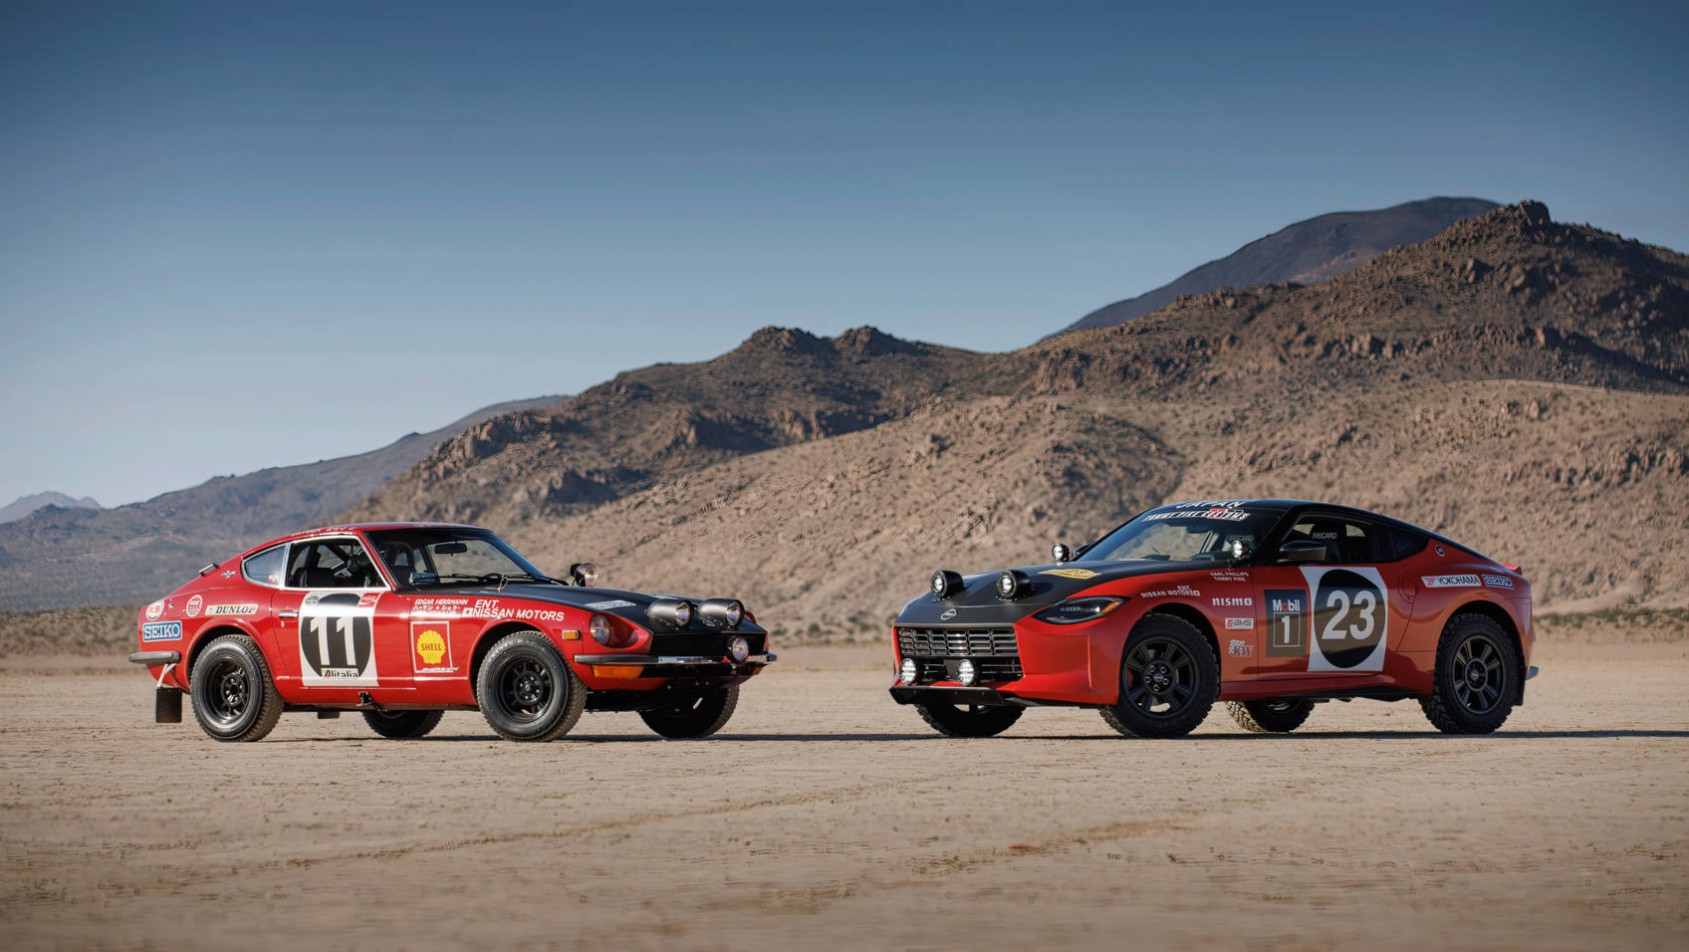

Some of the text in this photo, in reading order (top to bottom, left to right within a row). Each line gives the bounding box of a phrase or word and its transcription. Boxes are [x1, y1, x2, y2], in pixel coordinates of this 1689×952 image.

[1439, 575, 1480, 586] YOKOHAMA
[1484, 575, 1513, 588] SEIKO
[1140, 590, 1167, 598] NISSAN
[435, 598, 468, 606] HERRMANN
[1272, 599, 1300, 612] Mobil
[215, 604, 257, 614] DUNLOP
[473, 608, 565, 622] NISSAN MOTORS
[1321, 589, 1376, 640] 23
[144, 623, 181, 640] SEIKO
[1281, 615, 1291, 644] 1
[310, 614, 356, 666] 11
[420, 643, 442, 652] SHELL
[324, 669, 359, 678] Alitalia
